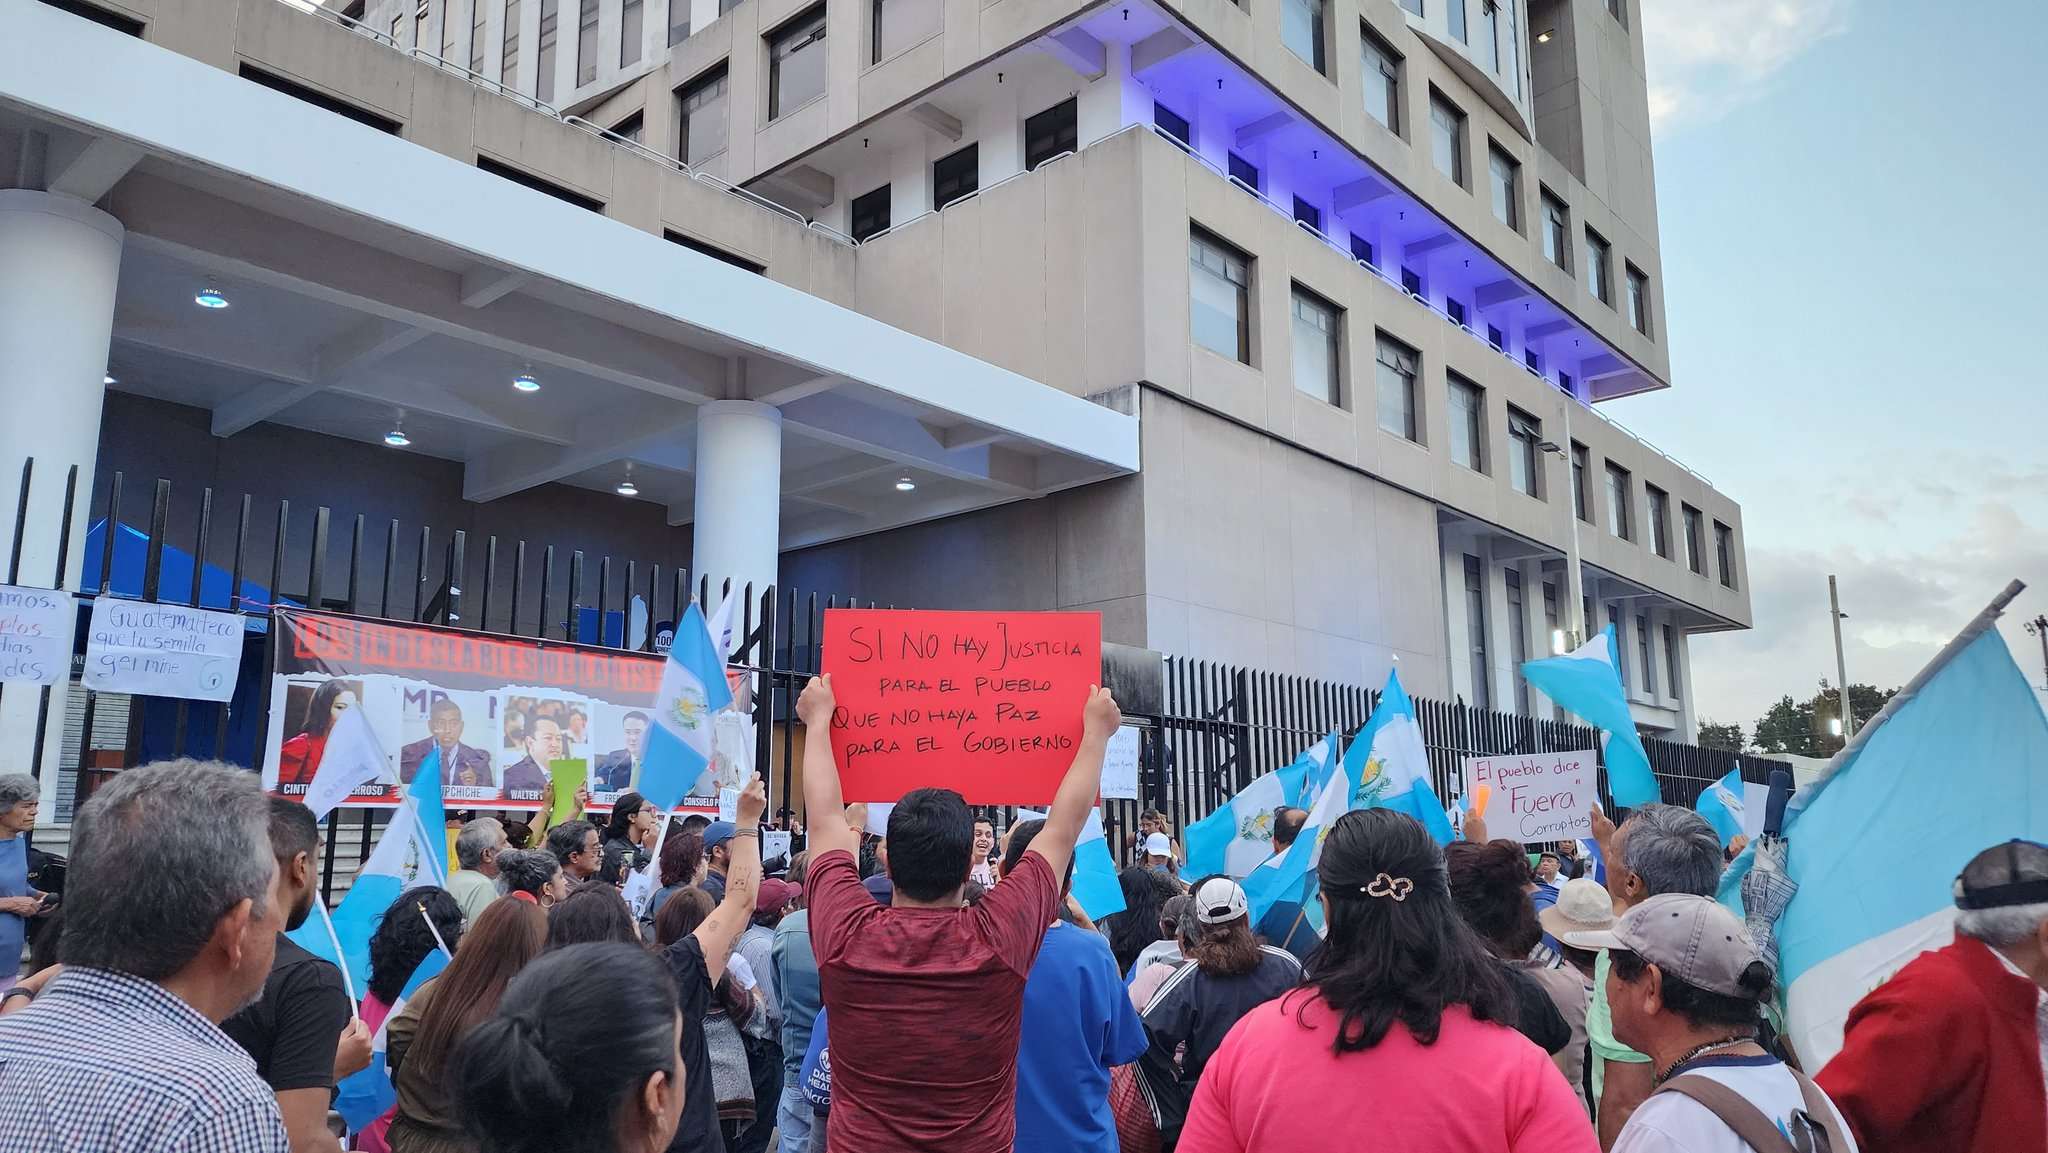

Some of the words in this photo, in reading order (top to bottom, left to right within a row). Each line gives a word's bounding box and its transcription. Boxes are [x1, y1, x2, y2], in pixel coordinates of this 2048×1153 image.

[110, 603, 236, 638] Guatemalteco
[95, 631, 126, 651] que
[153, 634, 206, 653] semilla
[849, 626, 883, 663] SI
[901, 630, 939, 660] NO
[953, 634, 989, 664] HAY
[991, 622, 1082, 671] JUSTICIA
[879, 677, 932, 697] PARA
[939, 678, 961, 693] EL
[975, 676, 1052, 697] PUEBLO
[831, 705, 880, 730] QUE
[890, 709, 920, 726] NO
[928, 709, 977, 730] HAYA
[996, 703, 1041, 723] PAZ
[846, 738, 901, 769] PARA
[916, 736, 944, 753] EL
[963, 731, 1072, 755] GOBIERNO
[1476, 760, 1492, 782] El
[1497, 759, 1543, 785] pueblo
[1553, 757, 1580, 775] dice
[510, 789, 539, 800] WALTER
[684, 797, 713, 807] CONSUELO
[1519, 813, 1591, 838] Corruptos
